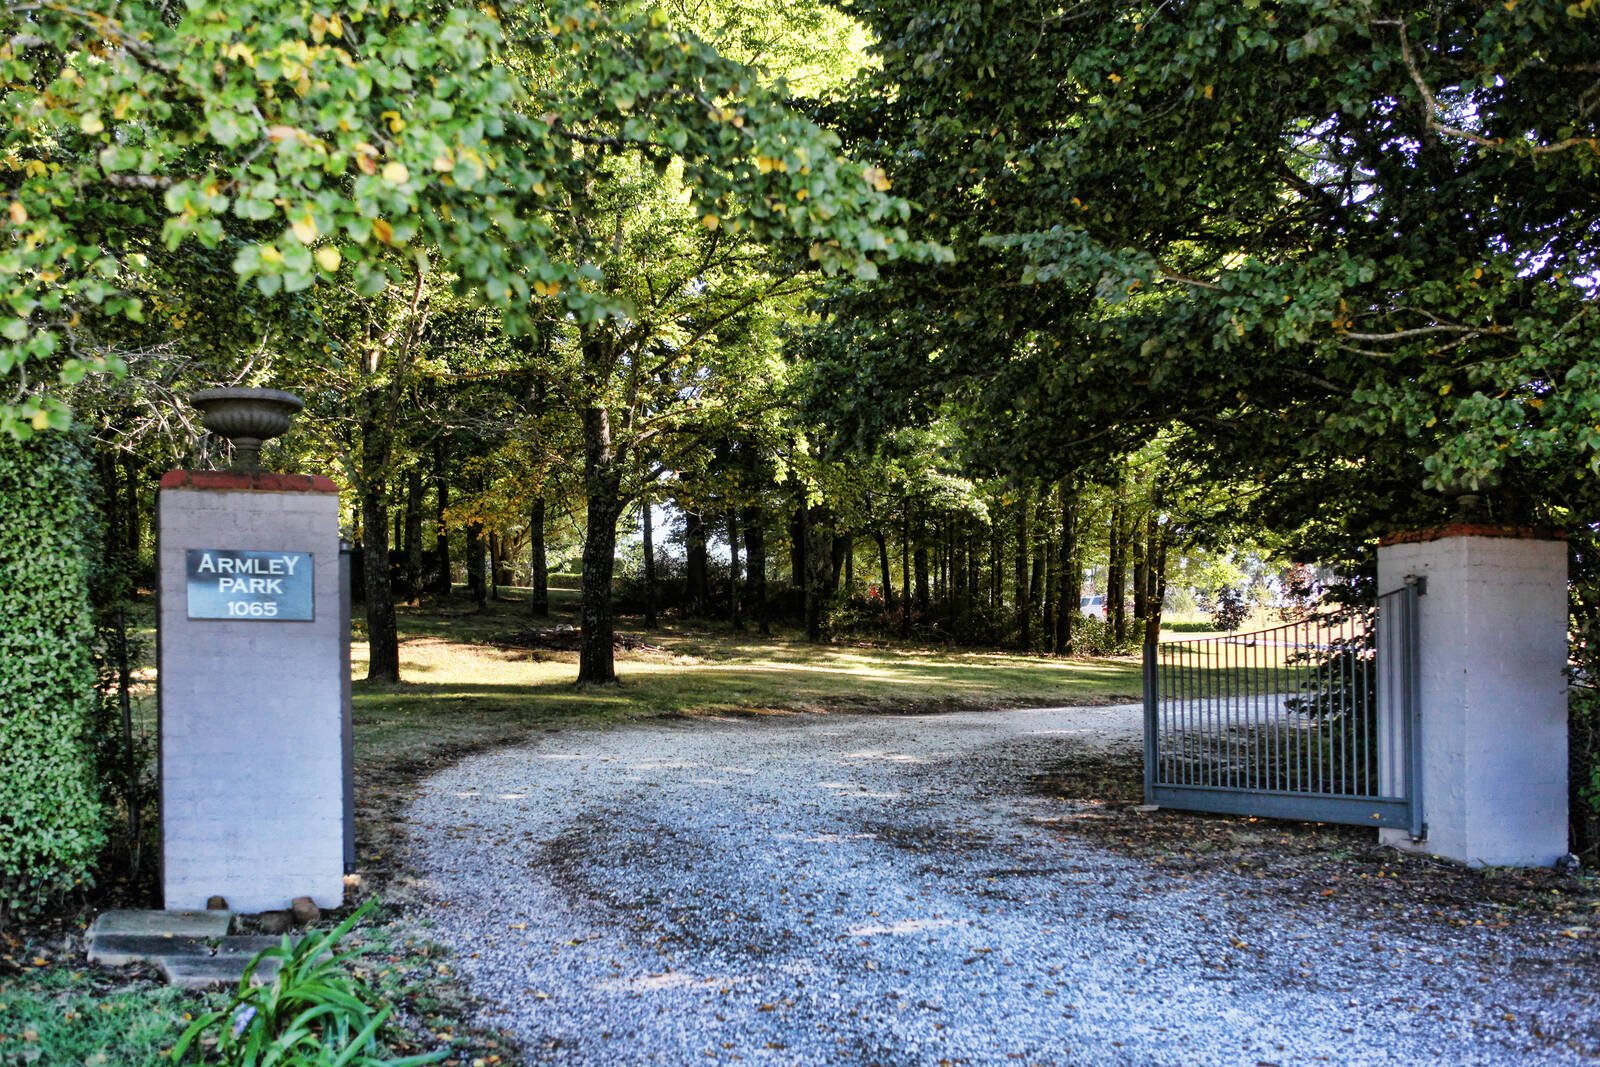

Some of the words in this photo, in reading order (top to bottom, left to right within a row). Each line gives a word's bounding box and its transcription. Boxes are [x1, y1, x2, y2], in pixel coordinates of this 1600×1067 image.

[197, 552, 300, 575] ARMLEY
[218, 577, 283, 594] PARK
[227, 601, 278, 616] 1065
